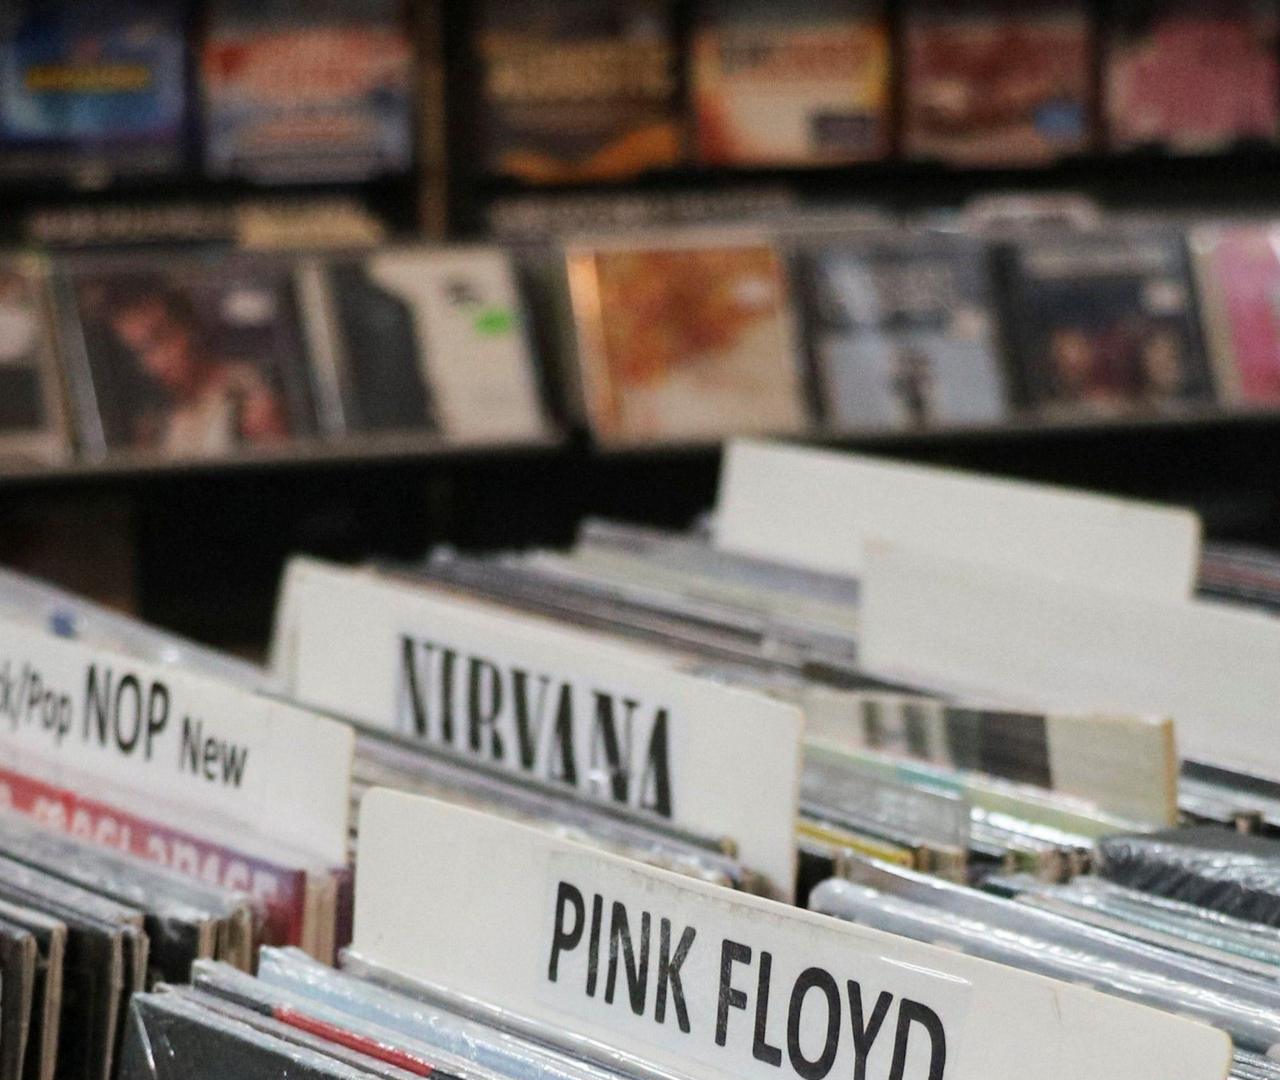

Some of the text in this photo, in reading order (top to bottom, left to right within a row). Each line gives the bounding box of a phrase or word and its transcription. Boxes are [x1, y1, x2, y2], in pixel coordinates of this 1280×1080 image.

[83, 663, 171, 761] NOP
[180, 717, 249, 788] New
[399, 633, 674, 820] NIRVANA
[548, 880, 697, 1034] PINK
